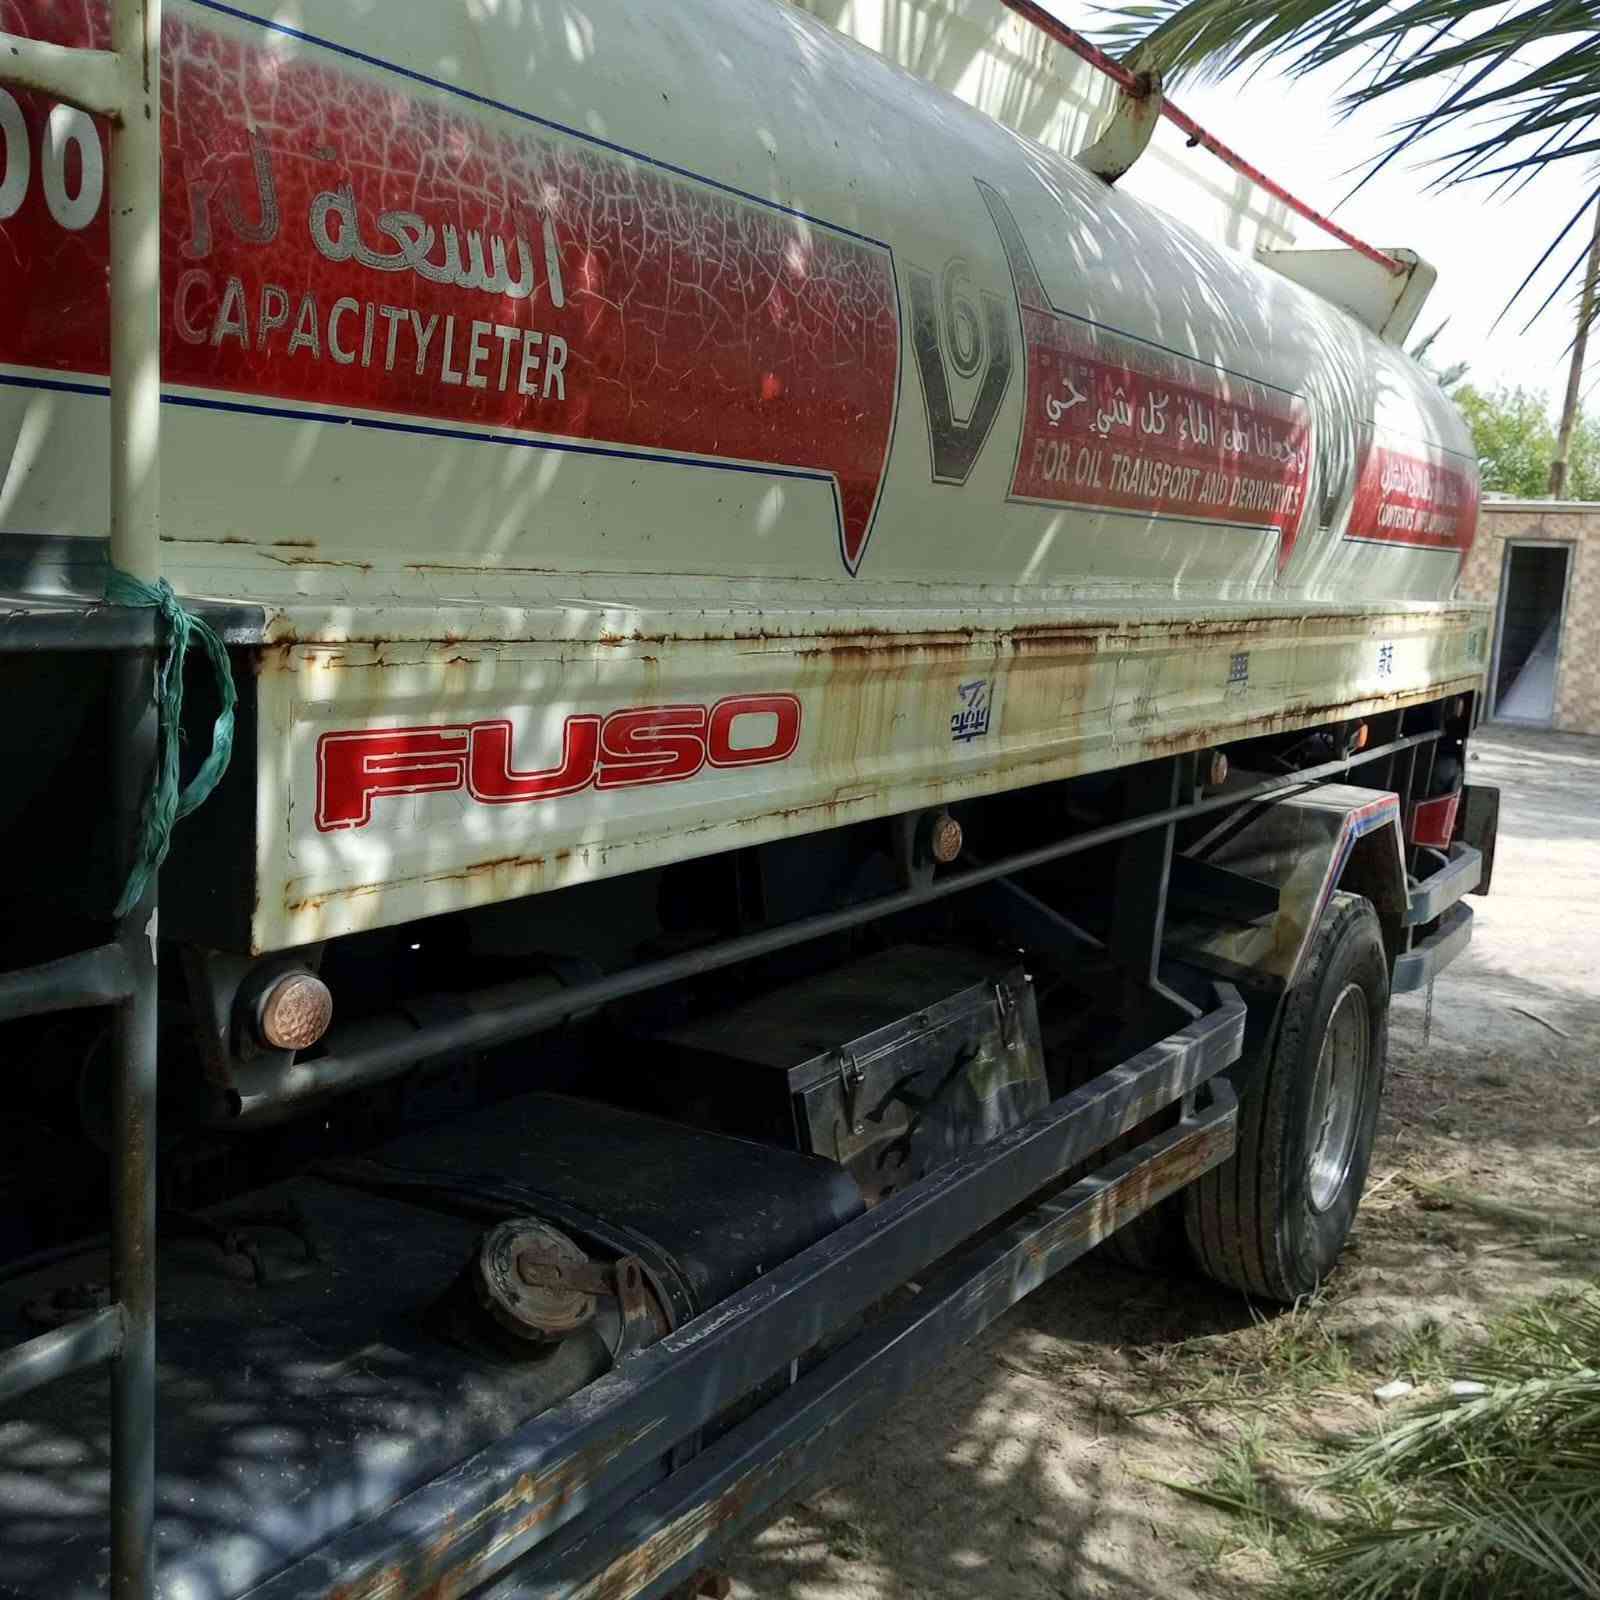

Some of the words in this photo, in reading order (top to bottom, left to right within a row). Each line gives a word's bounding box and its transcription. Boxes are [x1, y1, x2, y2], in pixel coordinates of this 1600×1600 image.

[1031, 439, 1070, 482] FOR
[1075, 447, 1103, 489] OIL
[1109, 453, 1200, 501] TRANSPORT
[1198, 472, 1228, 505] AND
[316, 692, 801, 832] FUSO
